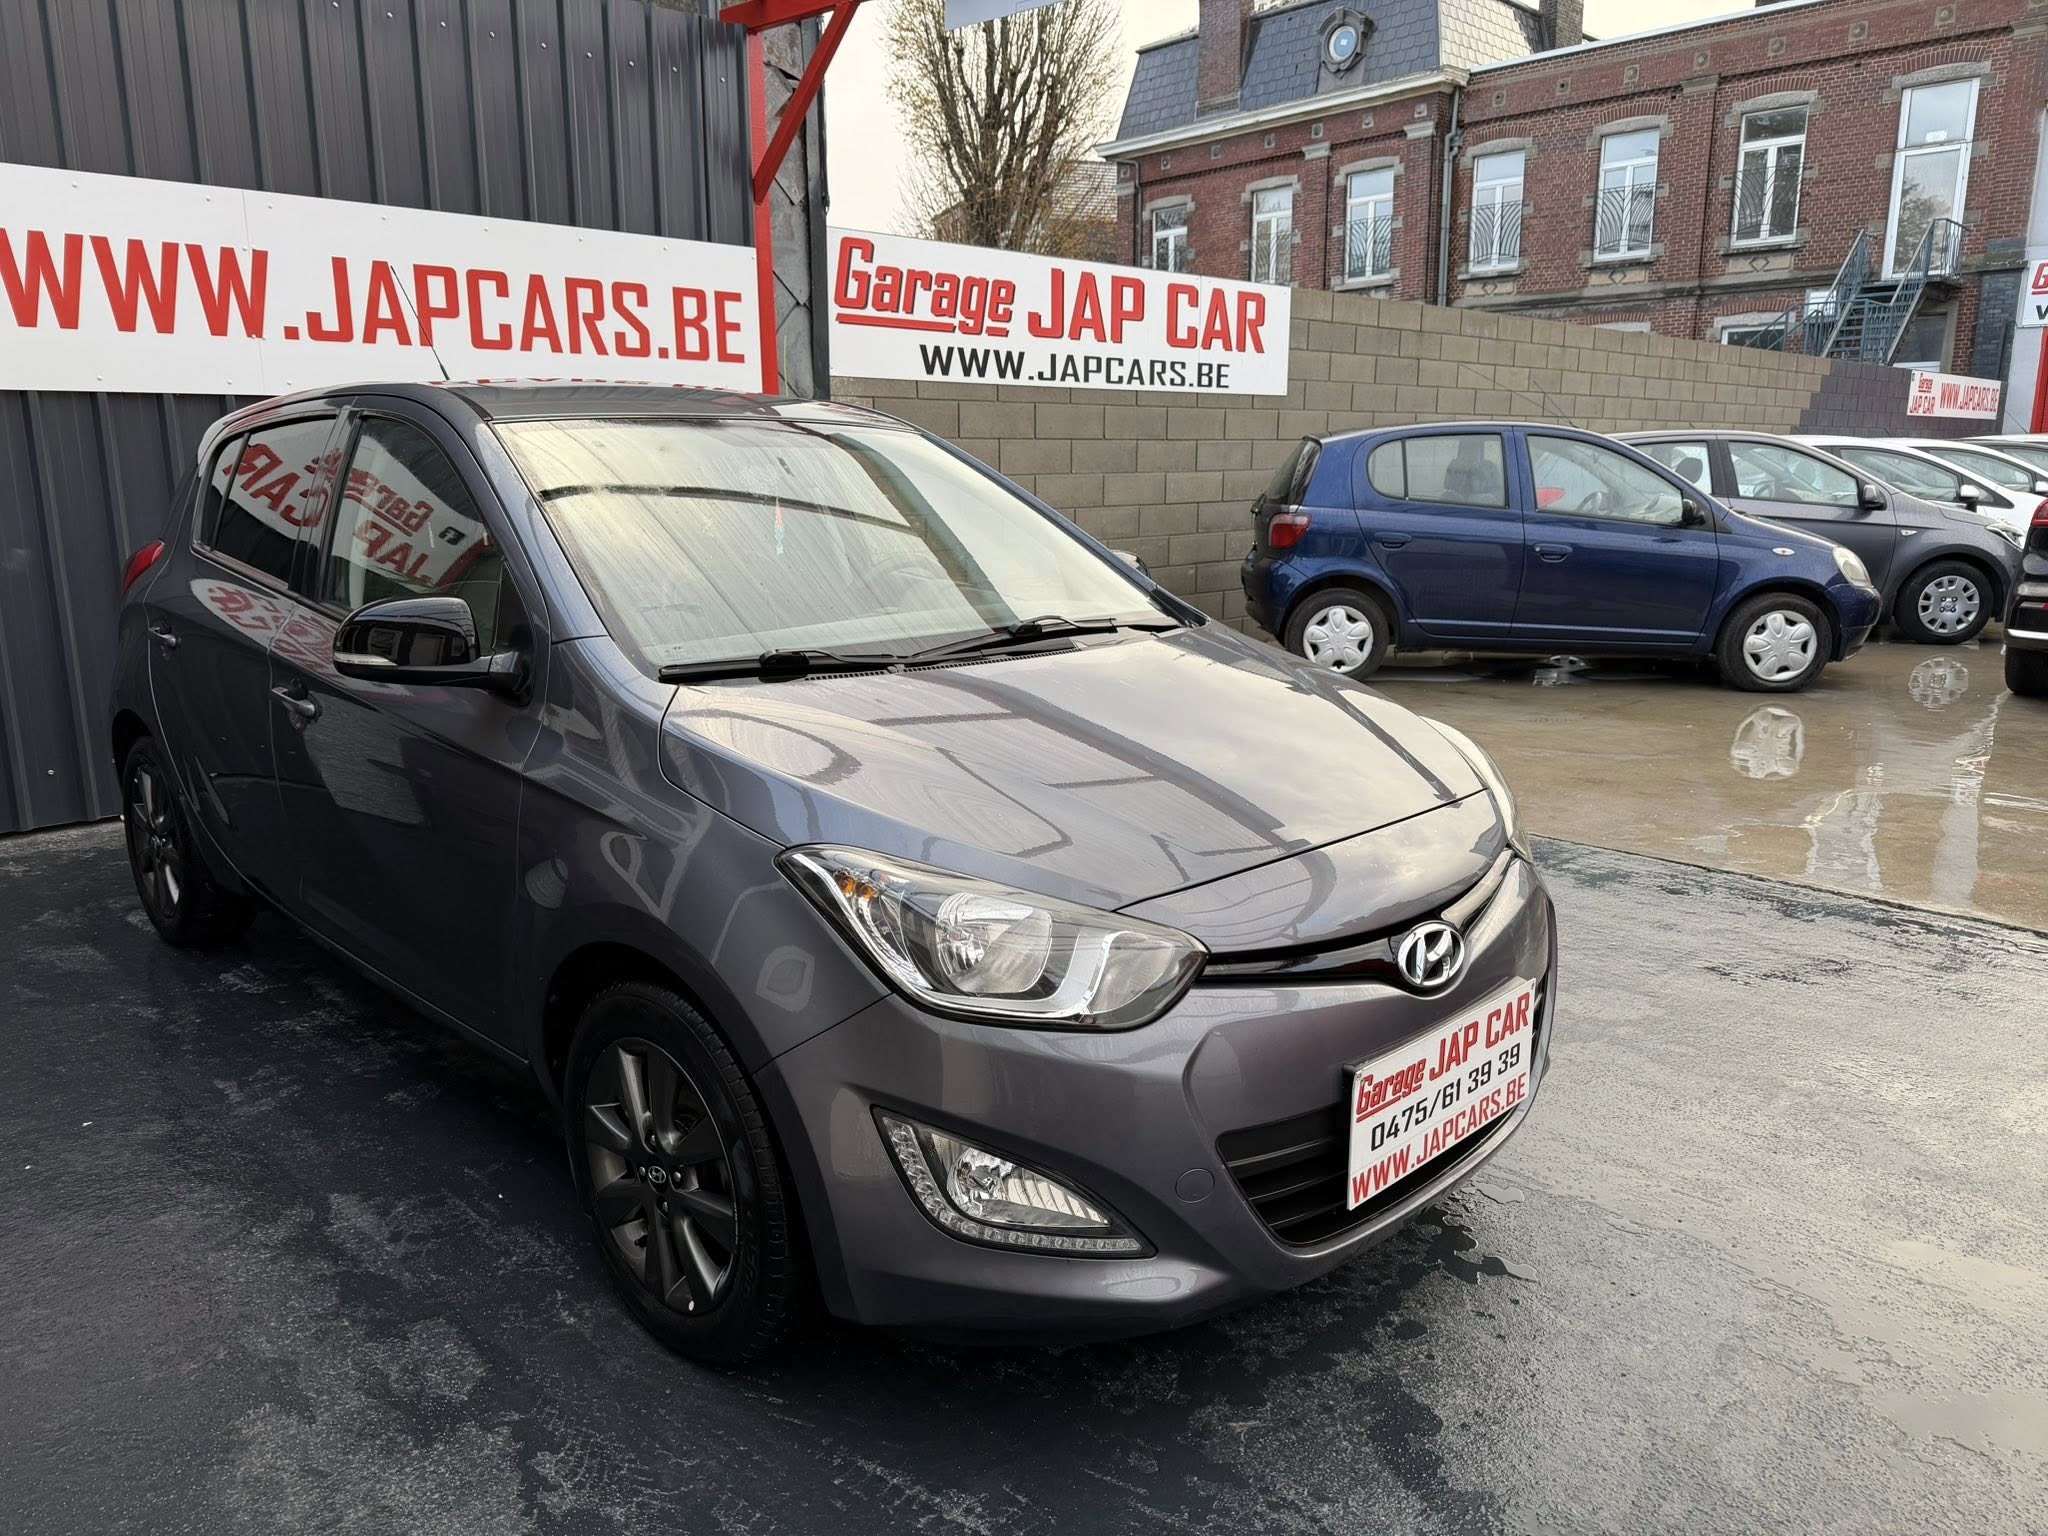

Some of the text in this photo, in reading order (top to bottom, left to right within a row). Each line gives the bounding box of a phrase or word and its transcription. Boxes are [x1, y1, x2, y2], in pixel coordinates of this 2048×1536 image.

[0, 227, 746, 364] WWW.JAPCARS.BE
[834, 236, 1266, 354] Garage JAP CAR
[919, 344, 1230, 389] WWW.JAPCARS.BE
[1356, 992, 1531, 1116] Garage JAP CAR
[1371, 1042, 1521, 1152] 0475/61 39 39
[1352, 1072, 1527, 1204] WWW.JAPCARS.BE
